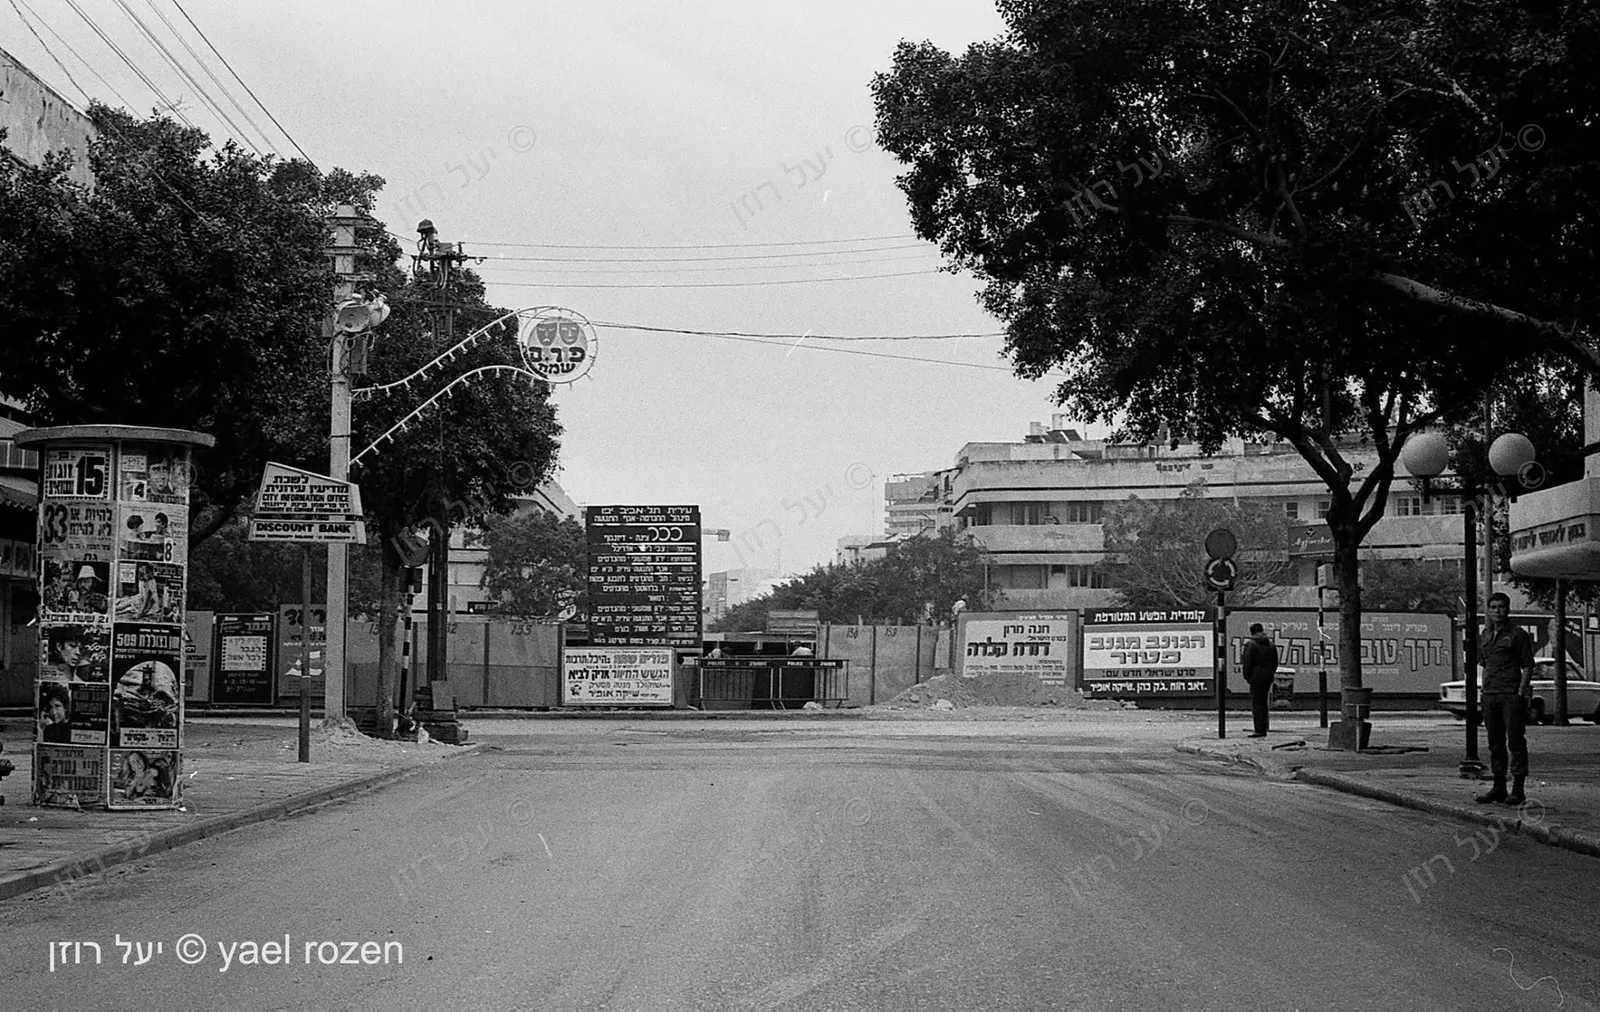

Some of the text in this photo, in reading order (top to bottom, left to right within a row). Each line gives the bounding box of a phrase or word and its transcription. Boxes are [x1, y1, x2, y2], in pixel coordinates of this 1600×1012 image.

[76, 456, 104, 496] 15
[273, 474, 309, 484] לשכת
[264, 484, 349, 494] מודיעין עירונית
[280, 494, 324, 502] INFORMATION
[327, 494, 350, 502] OFFICE
[70, 508, 112, 522] להיות או
[44, 504, 68, 544] 33
[70, 522, 112, 536] לא להיות
[256, 523, 351, 533] DISCOUNT BANK
[164, 543, 173, 562] 8
[1094, 610, 1205, 624] קומדית הפשע המטורפת
[1004, 625, 1050, 638] חנה מרון
[117, 634, 137, 647] 509
[967, 636, 1051, 657] דודה קלרה
[1090, 636, 1205, 650] הגונב מגנב
[638, 654, 670, 664] פורים
[1110, 651, 1181, 664] פטור
[568, 668, 669, 681] הגשש החיוור אריק לביא
[1145, 668, 1174, 676] ישראלי
[635, 680, 662, 689] שוקולד
